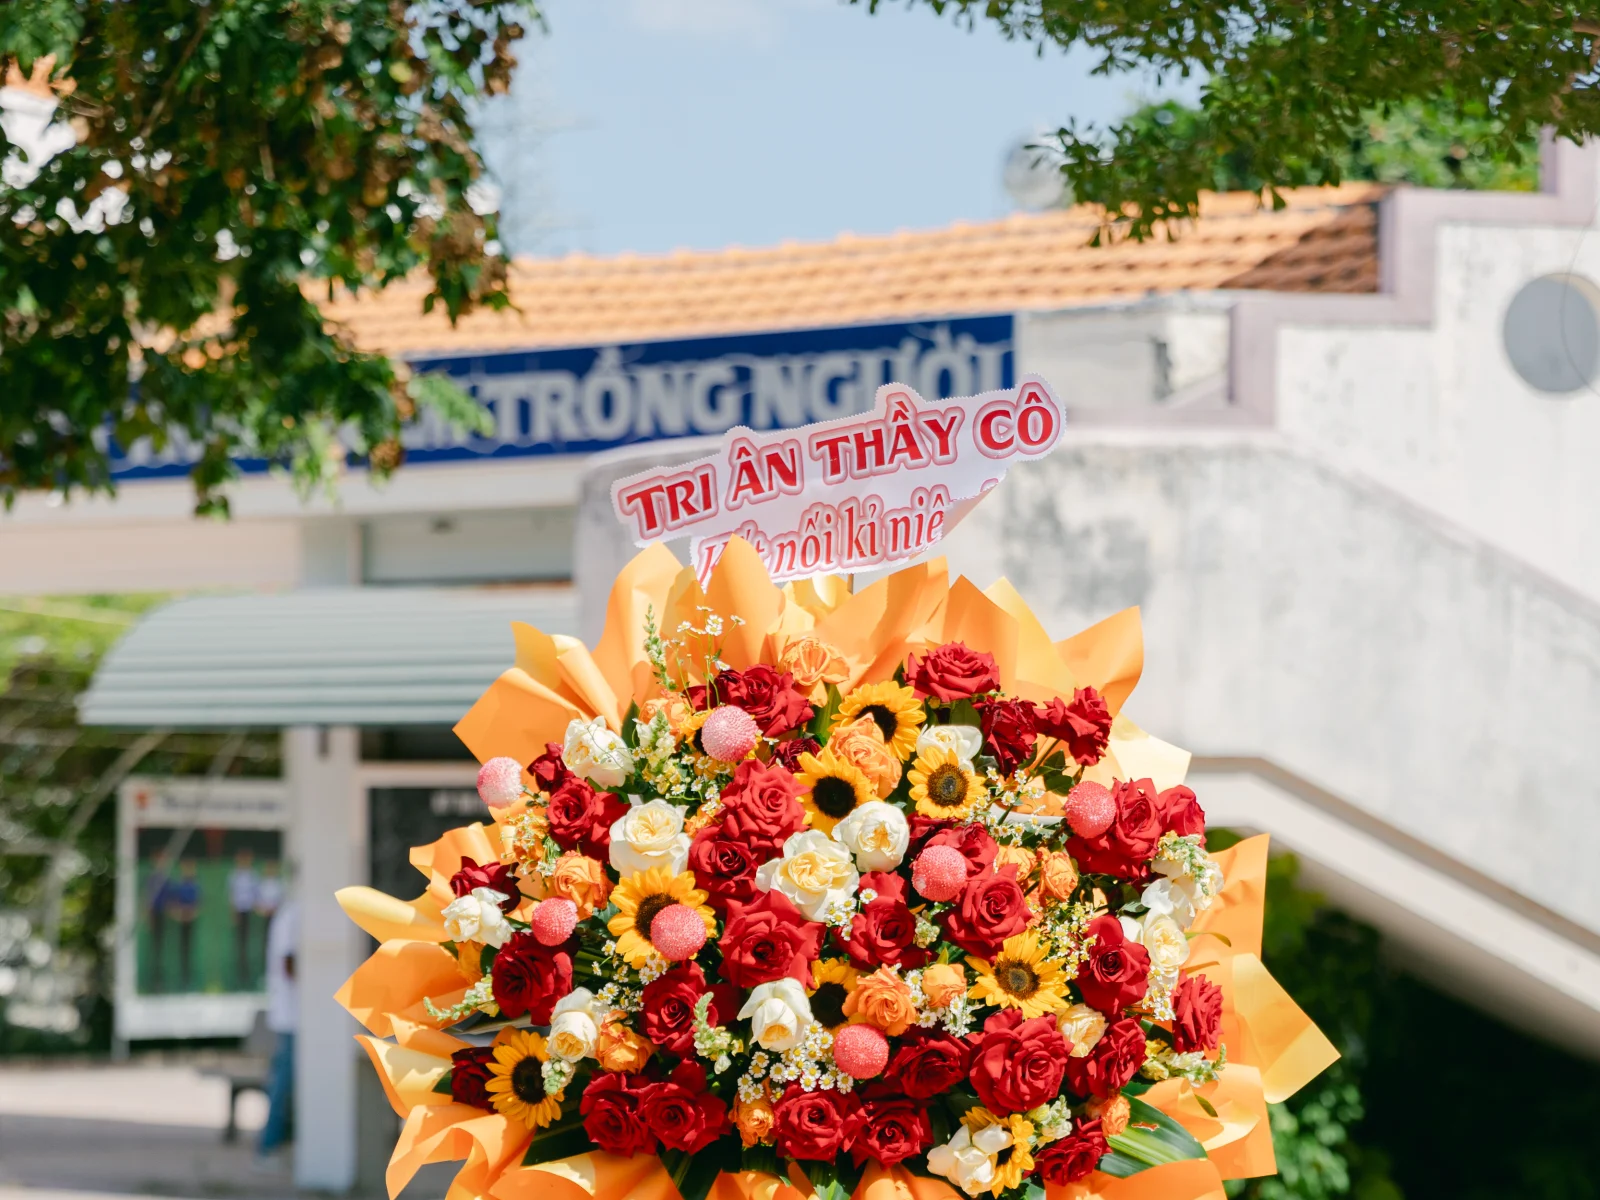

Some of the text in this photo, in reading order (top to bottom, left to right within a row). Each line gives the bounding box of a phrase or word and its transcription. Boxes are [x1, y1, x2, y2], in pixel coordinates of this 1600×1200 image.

[624, 391, 1055, 532] TRI ÂN THẦY CÔ
[773, 510, 835, 574] nối
[844, 502, 879, 561] kỉ
